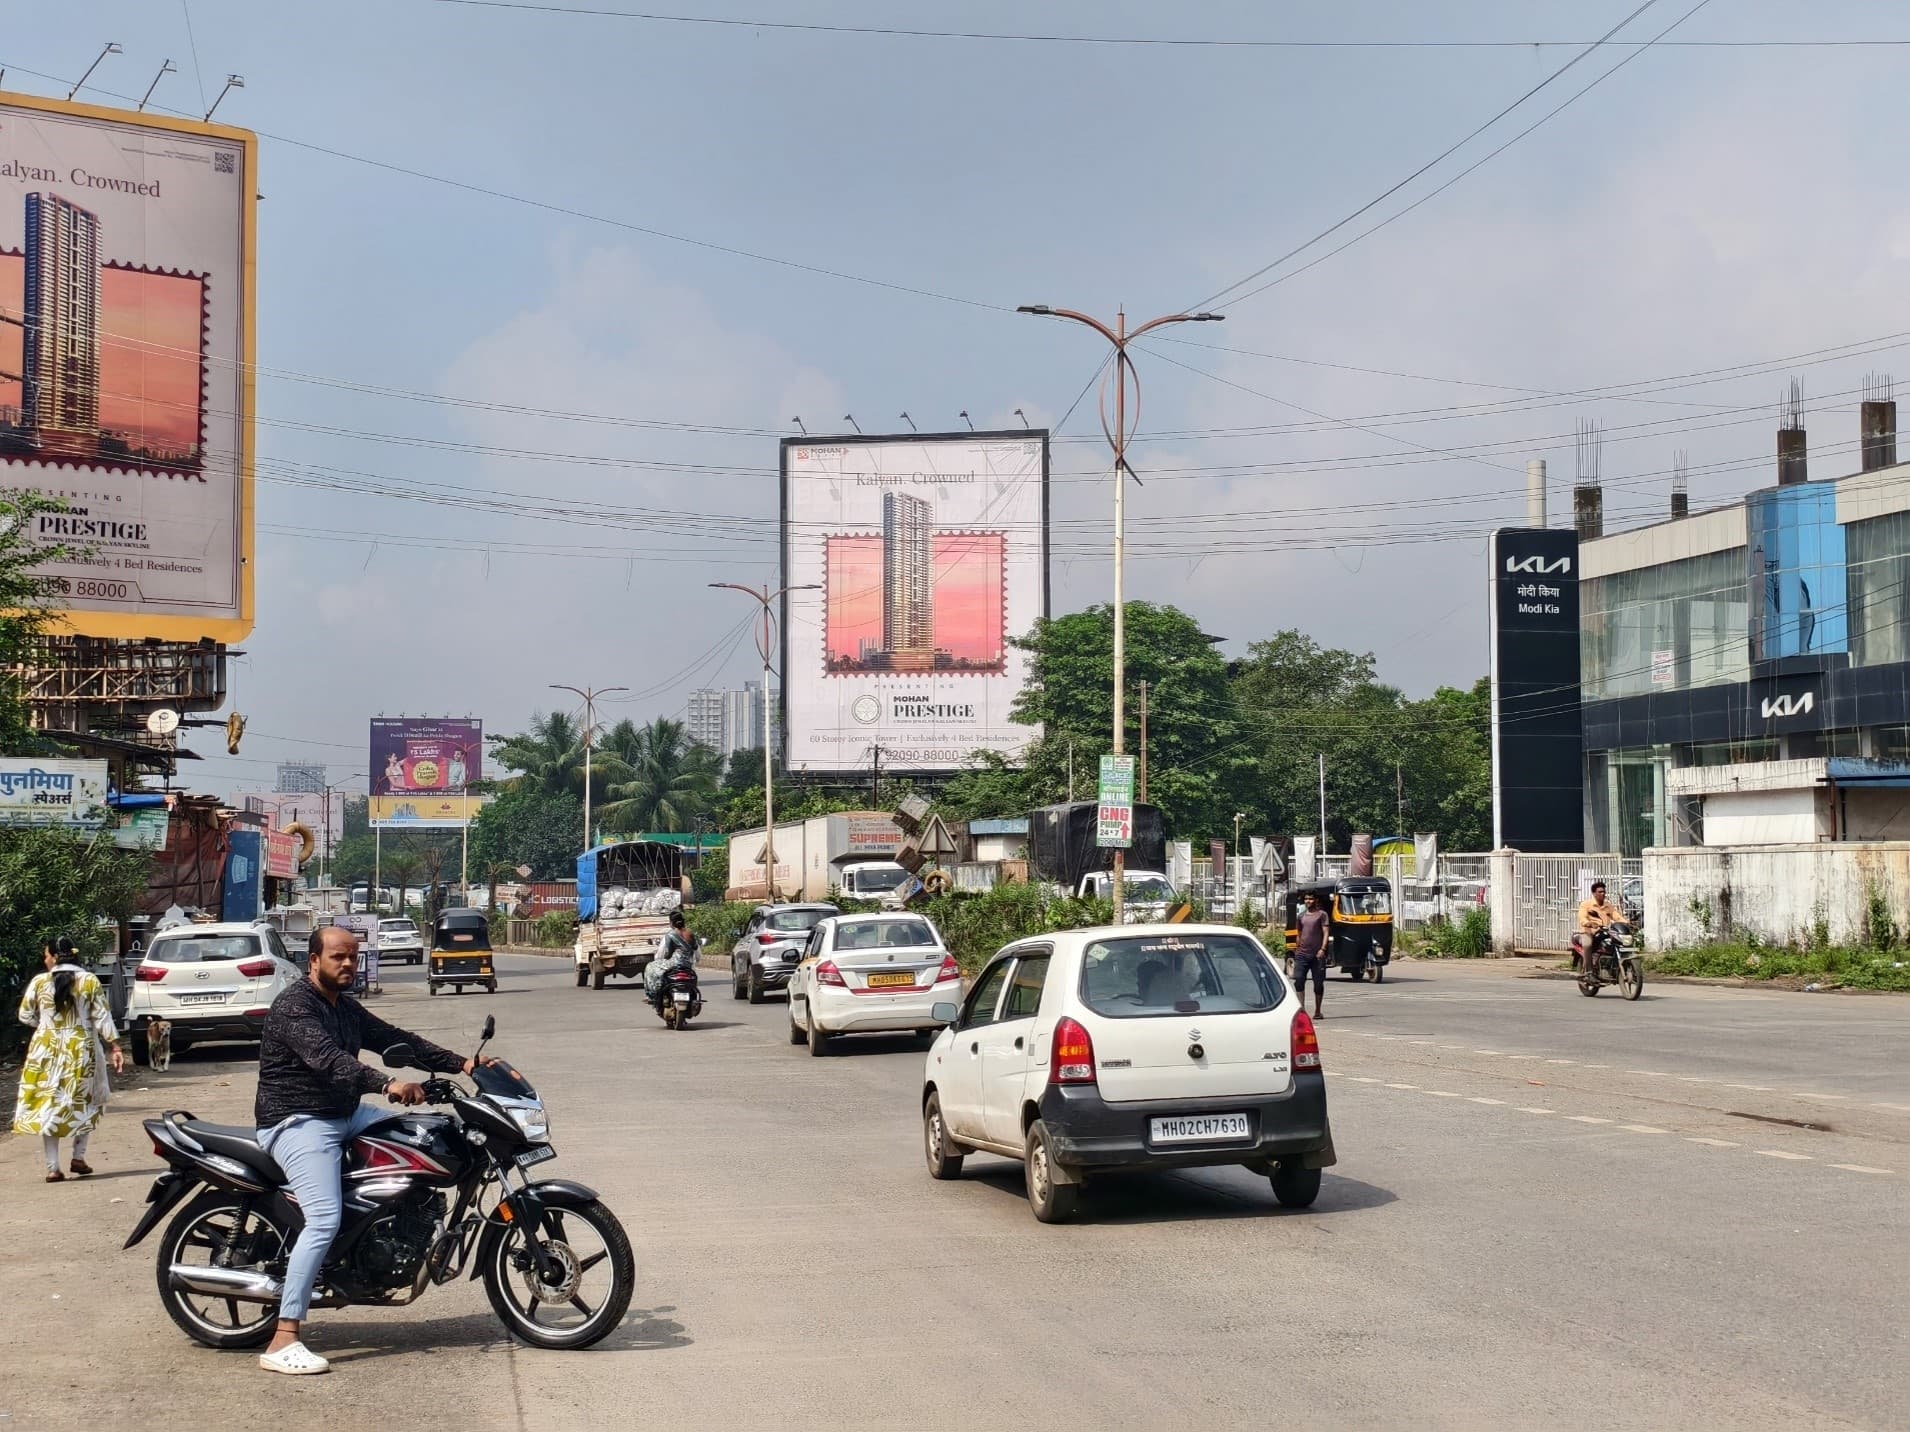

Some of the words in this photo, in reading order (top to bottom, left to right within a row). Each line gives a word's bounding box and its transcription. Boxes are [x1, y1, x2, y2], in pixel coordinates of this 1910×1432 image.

[0, 159, 62, 184] alyan.
[70, 167, 161, 198] Crowned
[856, 473, 906, 488] Kalyan.
[912, 470, 974, 484] Crowned
[40, 517, 147, 541] PRESTIGE
[114, 558, 120, 568] 4
[125, 558, 144, 570] Bed
[147, 562, 203, 574] Residences
[1506, 555, 1571, 574] KIA
[77, 581, 127, 598] 88000
[1517, 584, 1536, 597] मोदी
[1538, 584, 1560, 598] किया
[1518, 603, 1543, 614] Modi
[1545, 603, 1560, 614] Kia
[893, 695, 930, 703] MOHAN
[1761, 691, 1814, 719] KIA
[894, 704, 975, 718] PRESTIGE
[874, 735, 897, 743] Tower
[906, 735, 951, 744] Exclusively
[958, 734, 974, 743] Bed
[976, 734, 1020, 743] Residences
[885, 749, 920, 761] 92090
[923, 749, 960, 761] 88000
[1100, 807, 1129, 821] CNG
[1100, 821, 1122, 829] PUMP
[849, 833, 902, 844] SUPREME
[1161, 1117, 1246, 1137] MH02CH7630
